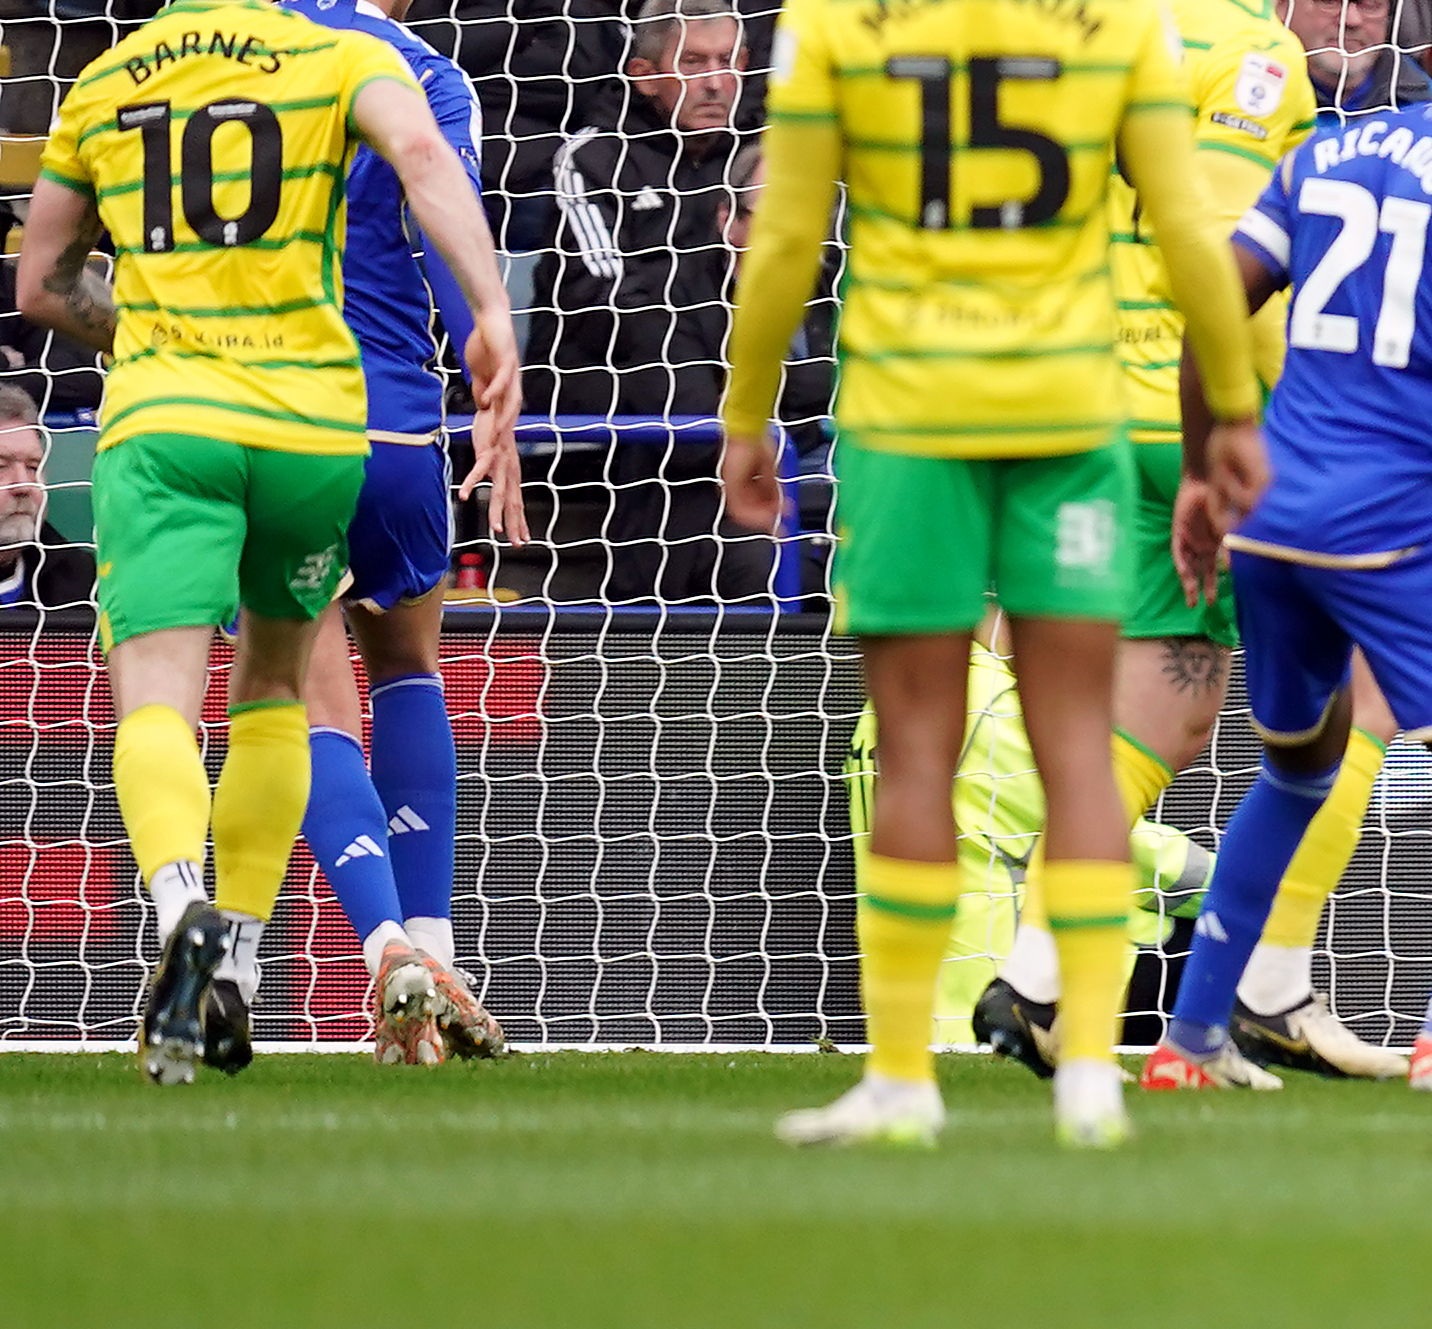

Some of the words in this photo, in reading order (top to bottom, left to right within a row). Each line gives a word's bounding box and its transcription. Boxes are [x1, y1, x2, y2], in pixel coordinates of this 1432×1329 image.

[124, 30, 290, 86] BARNES
[117, 97, 284, 254] 10
[885, 56, 1071, 230] 15
[1289, 176, 1432, 369] 21
